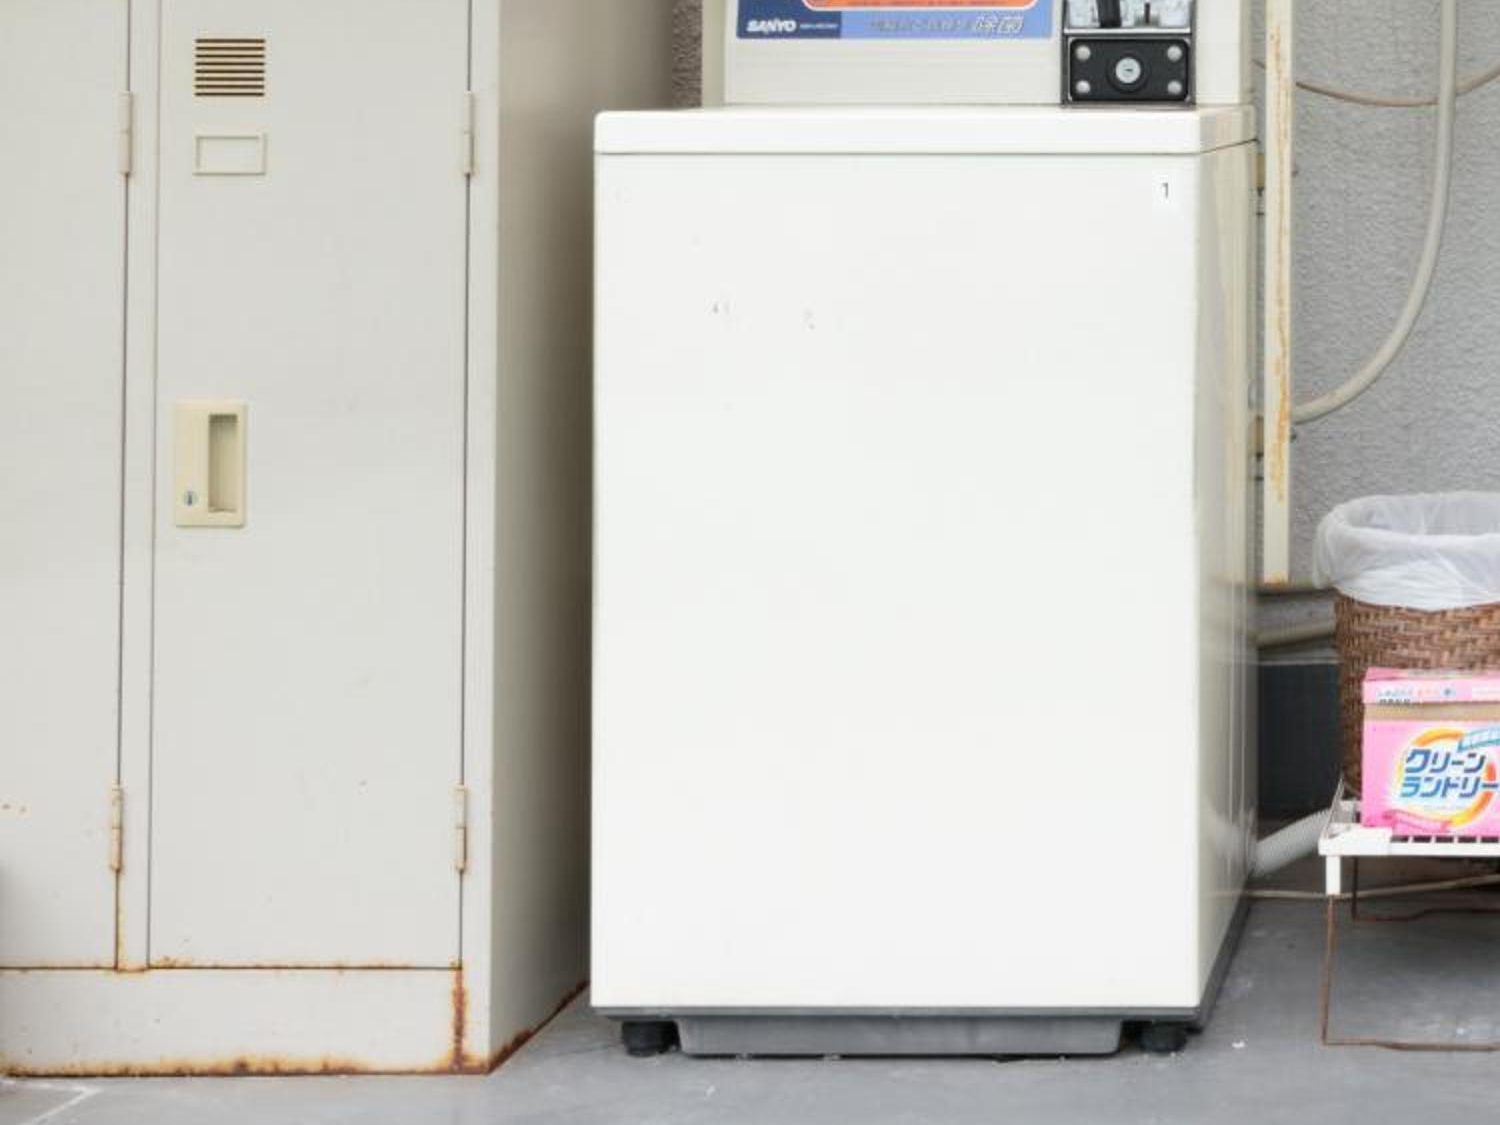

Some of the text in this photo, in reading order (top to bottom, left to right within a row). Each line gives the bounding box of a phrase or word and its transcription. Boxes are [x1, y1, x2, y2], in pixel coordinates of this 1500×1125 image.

[746, 18, 797, 33] SANYO
[1161, 182, 1169, 199] 1
[1405, 747, 1487, 774] クリーン
[1400, 776, 1500, 798] ランドリー
